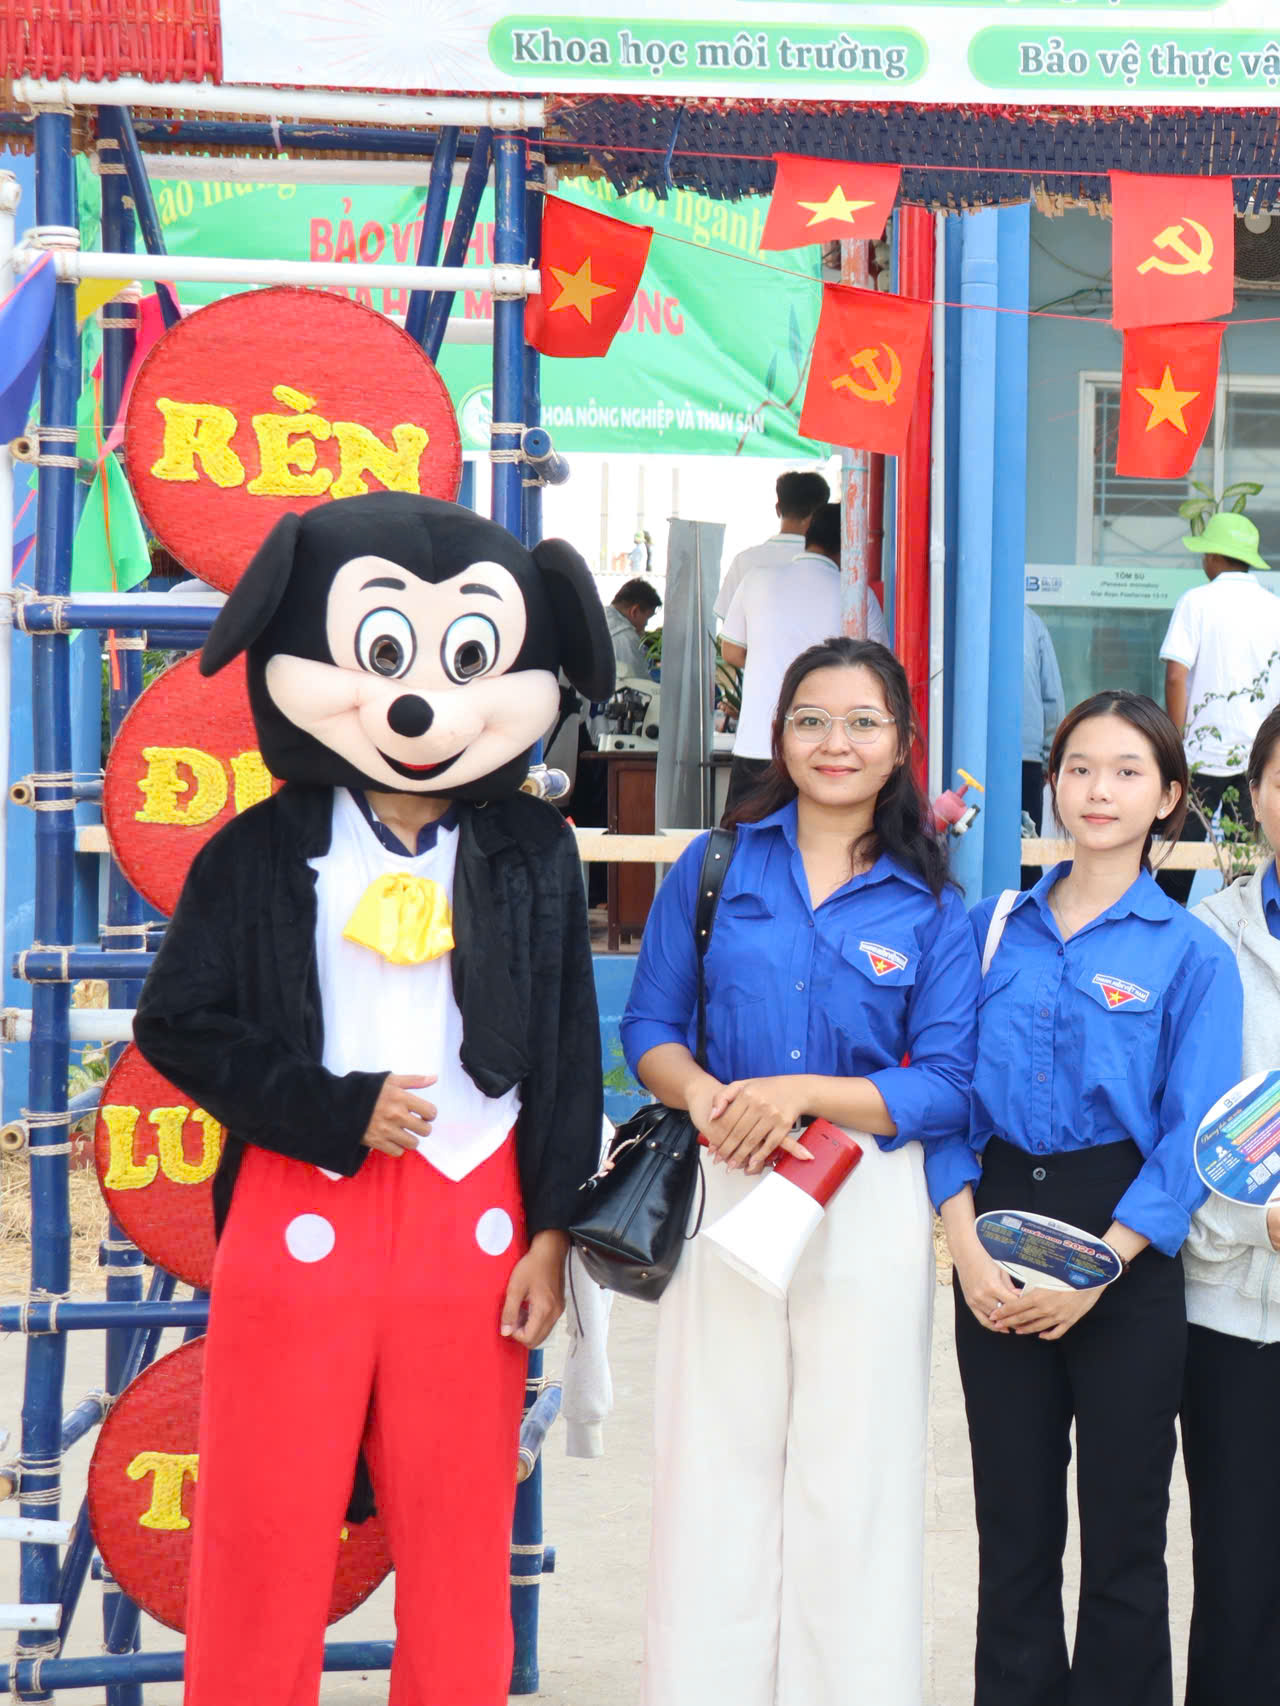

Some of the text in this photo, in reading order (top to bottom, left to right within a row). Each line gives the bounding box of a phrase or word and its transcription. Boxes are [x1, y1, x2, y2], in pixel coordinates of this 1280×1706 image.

[514, 31, 906, 79] Khoa học môi trường
[1019, 38, 1088, 74] Bảo
[1099, 42, 1139, 85] vệ
[1151, 44, 1231, 86] thực
[540, 405, 575, 427] HOA
[576, 398, 619, 427] NÔNG
[620, 398, 675, 437] NGHIỆP
[150, 384, 430, 500] RÈN
